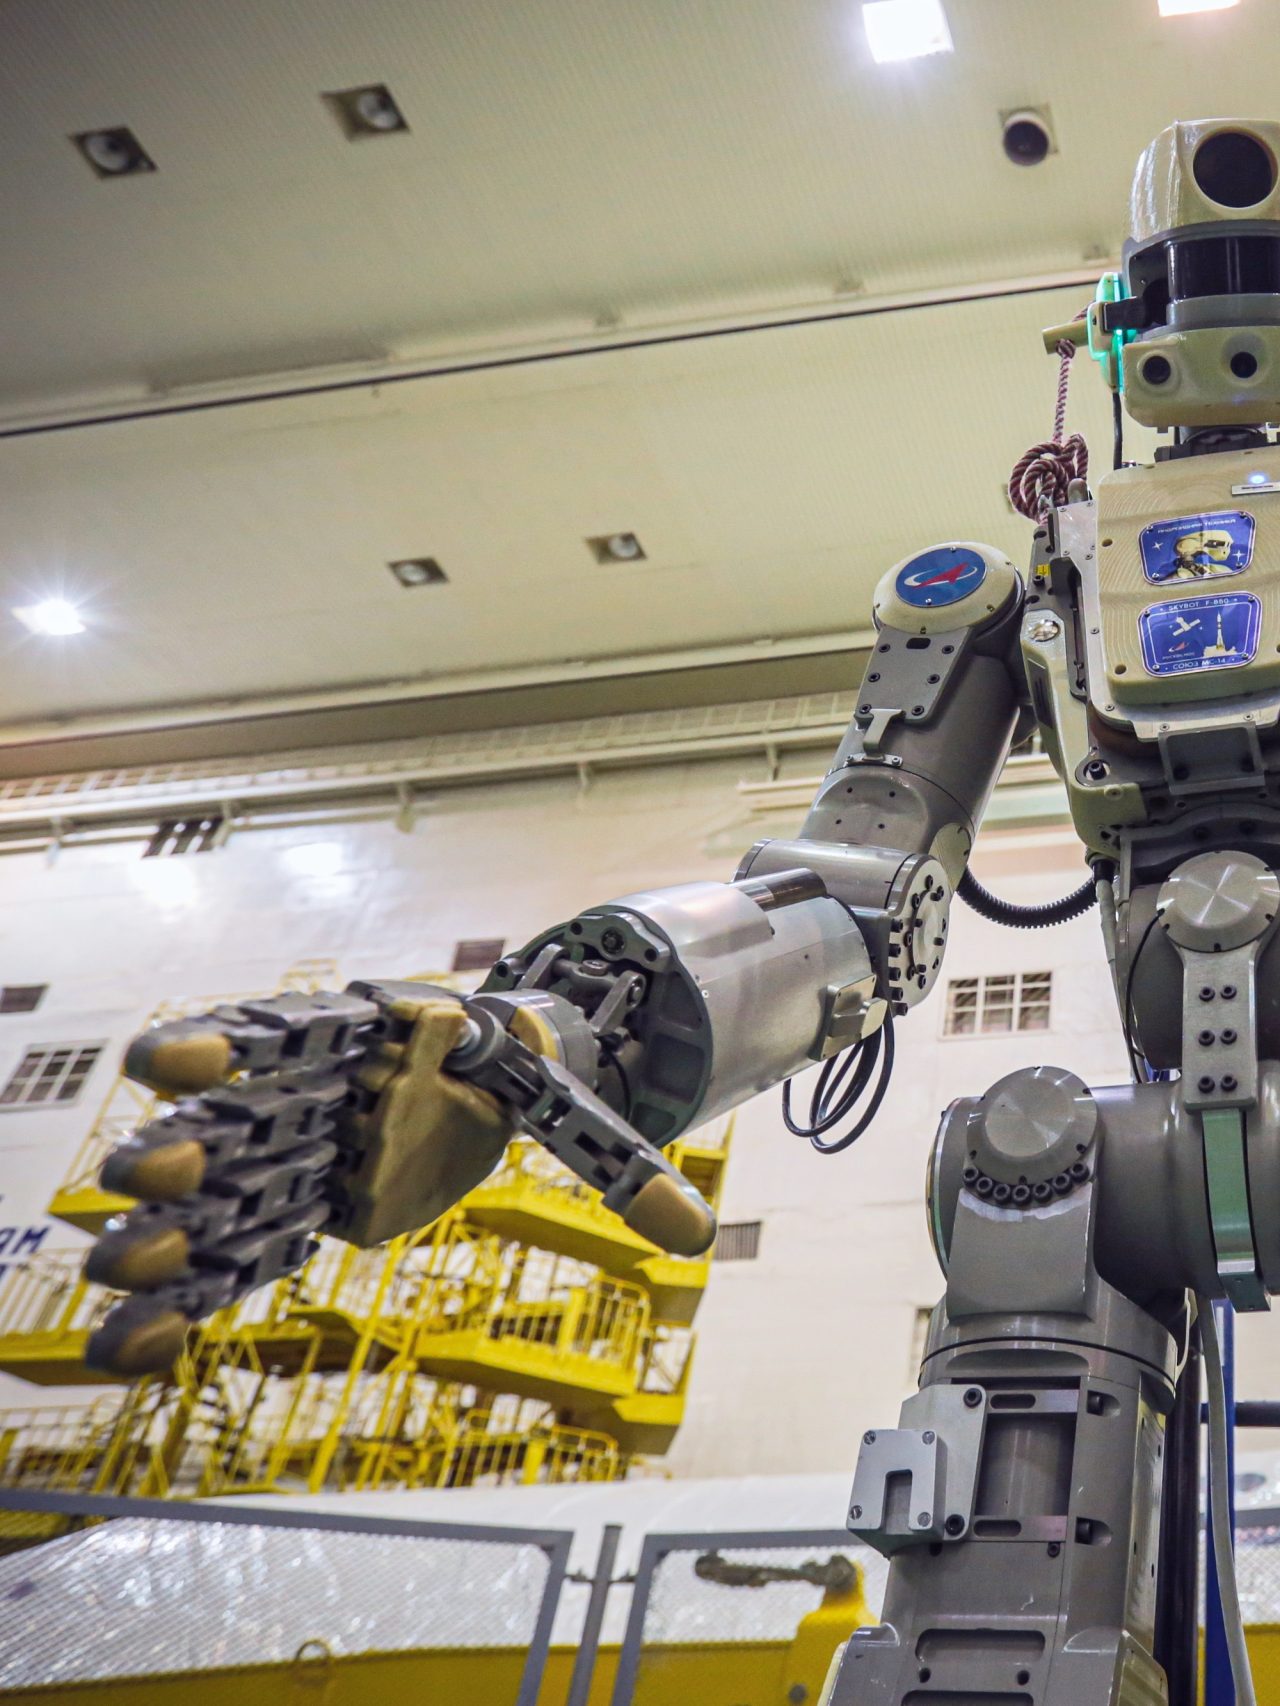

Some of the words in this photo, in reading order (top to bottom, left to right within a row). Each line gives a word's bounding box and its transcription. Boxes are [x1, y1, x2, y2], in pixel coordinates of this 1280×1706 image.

[1168, 602, 1200, 611] SKYBOT
[1172, 660, 1199, 670] СОЮЗ
[1201, 658, 1226, 666] МС-14
